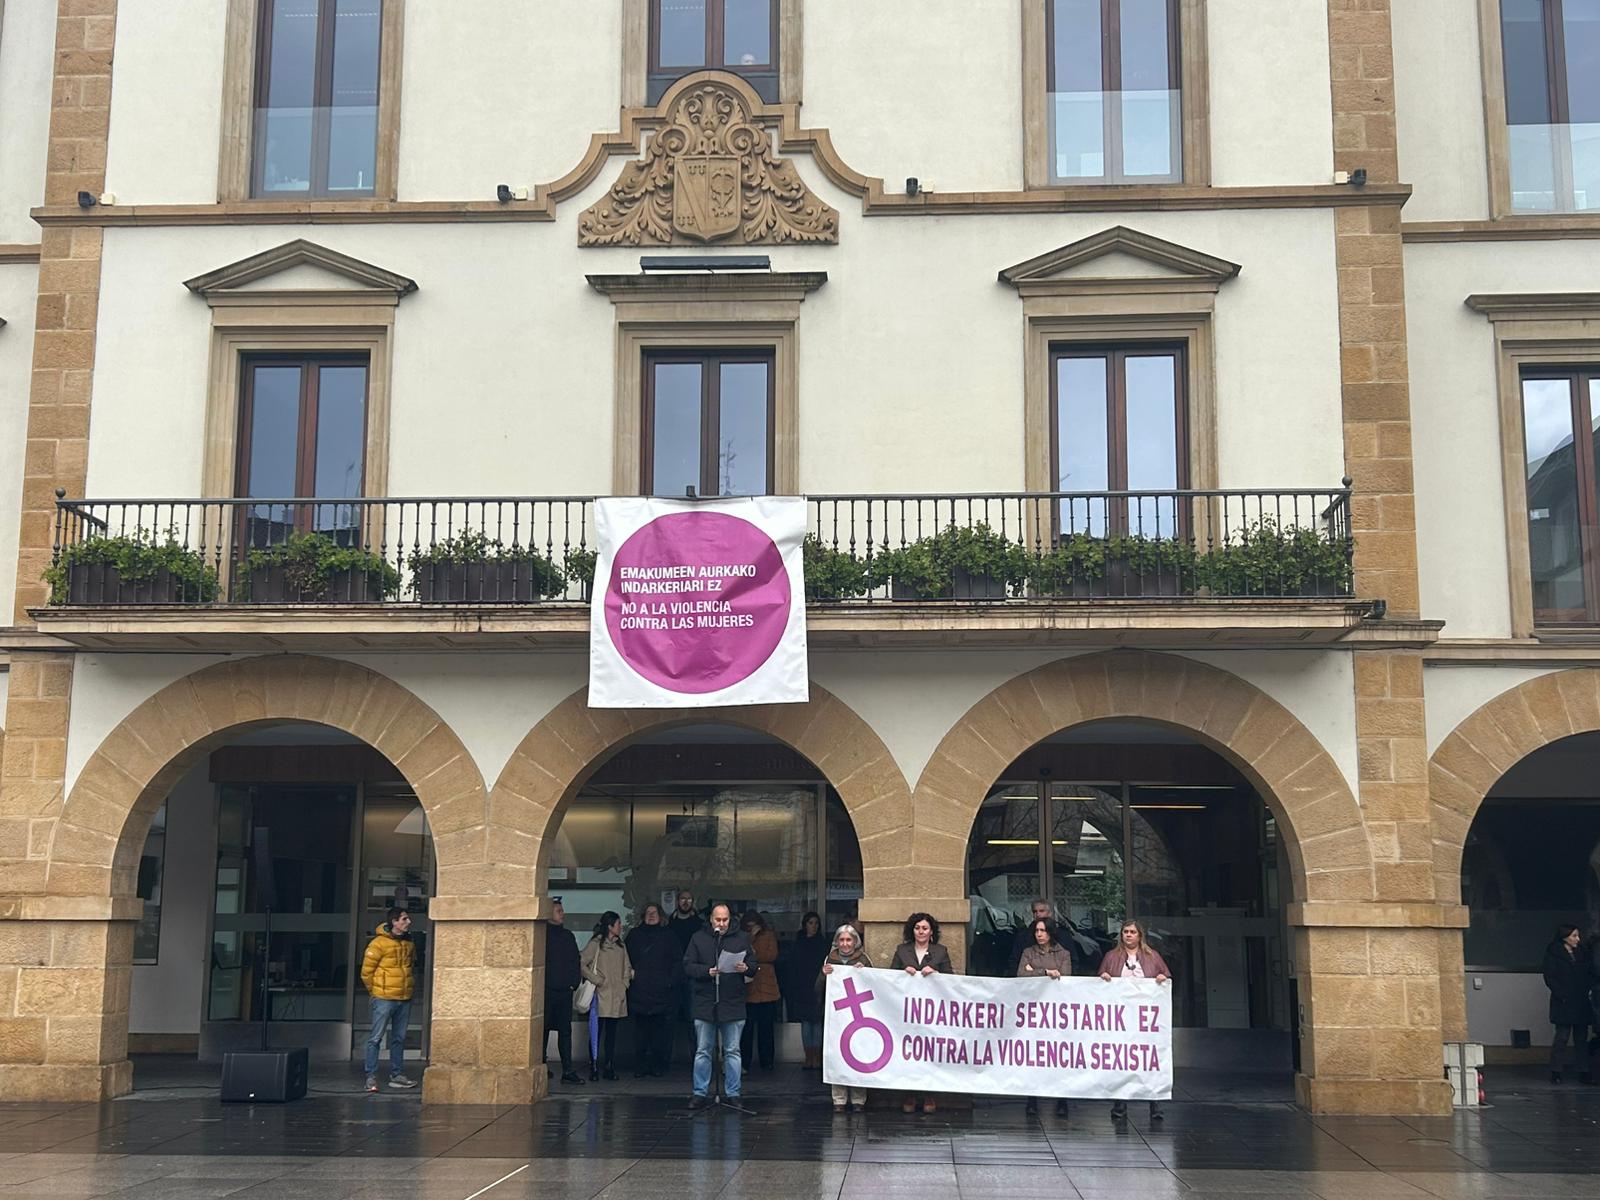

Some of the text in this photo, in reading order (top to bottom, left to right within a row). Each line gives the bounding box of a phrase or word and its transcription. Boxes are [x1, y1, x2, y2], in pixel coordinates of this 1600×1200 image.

[621, 565, 756, 579] EMAKUMEEN AURKAKO
[621, 580, 722, 594] INDARKERIARI EZ
[622, 601, 731, 614] NO A LA VIOLENCIA
[621, 615, 753, 630] CONTRA LAS MUJERES
[903, 997, 1159, 1032] INDARKERI SEXISTARIK EZ
[902, 1036, 1160, 1071] CONTRA LA VIOLENCIA SEXISTA
